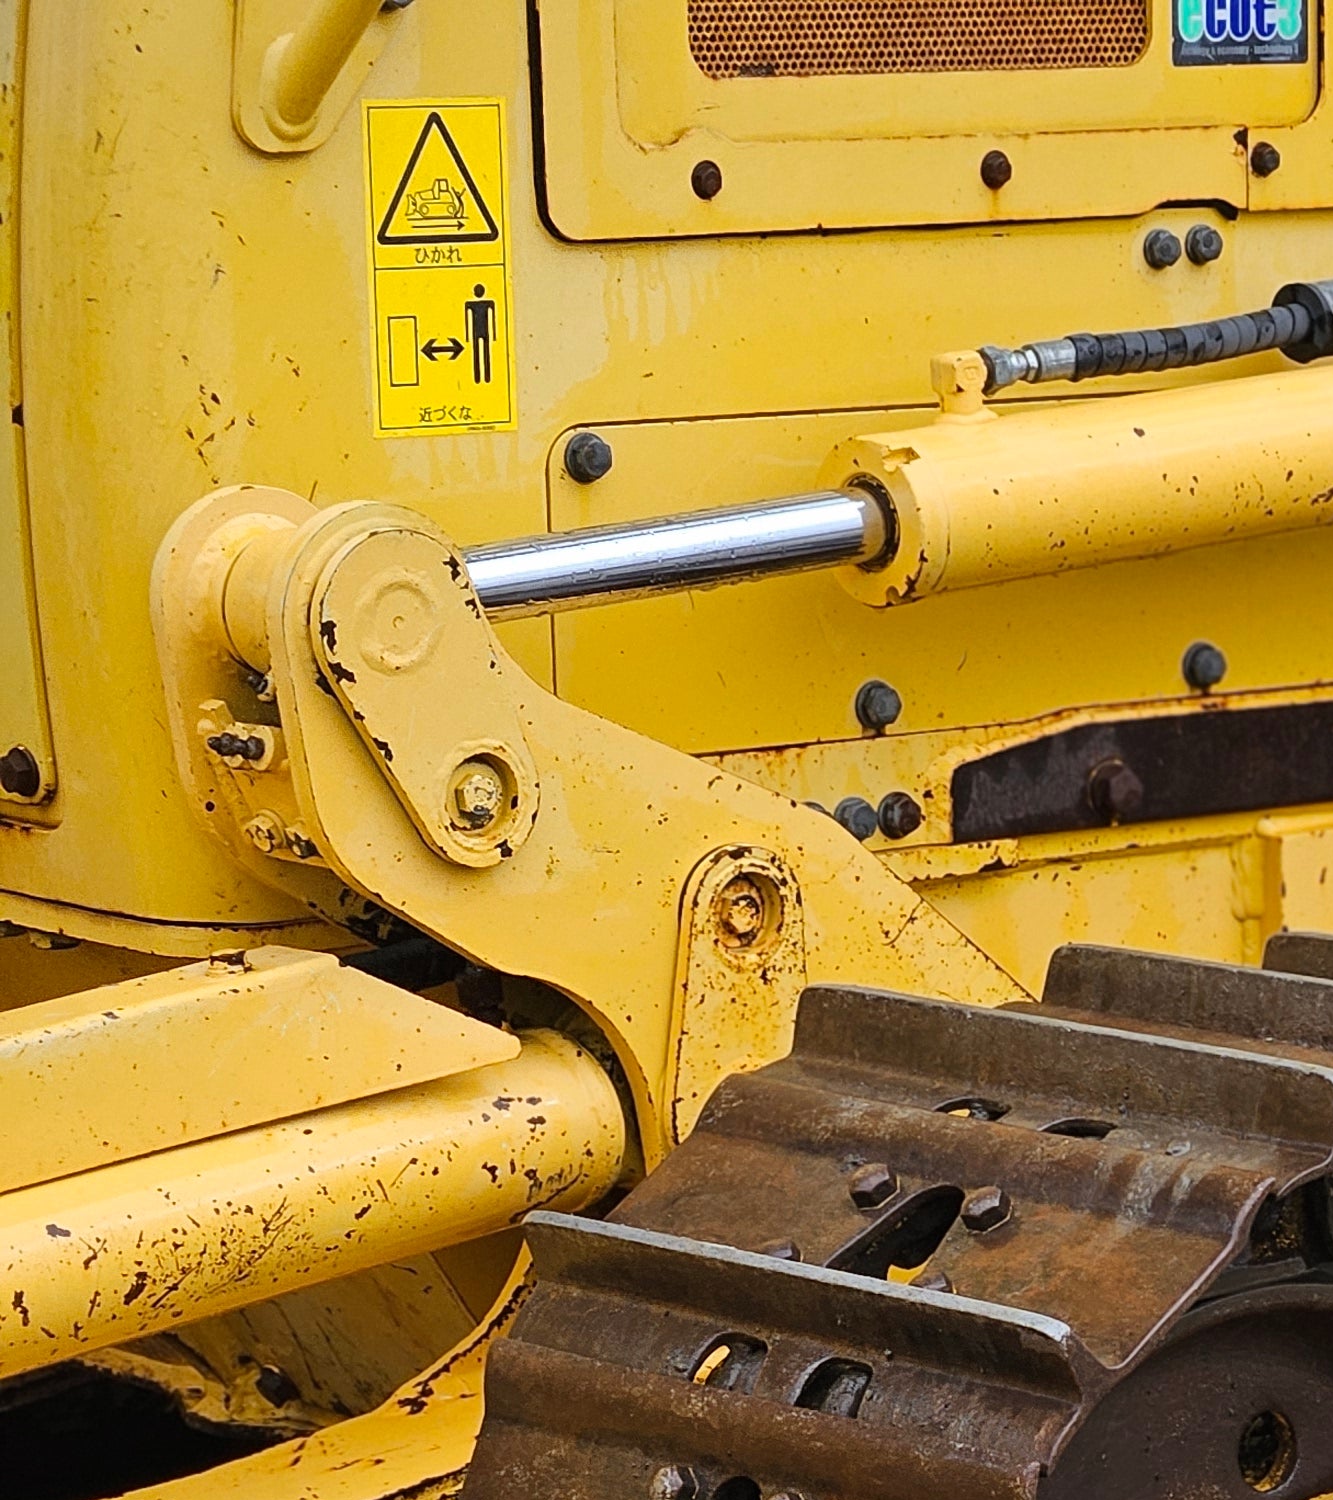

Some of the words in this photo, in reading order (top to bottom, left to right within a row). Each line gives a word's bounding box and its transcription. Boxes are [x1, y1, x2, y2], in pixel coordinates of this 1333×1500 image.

[415, 246, 462, 264] ひかれ
[419, 405, 473, 422] 近づくな
